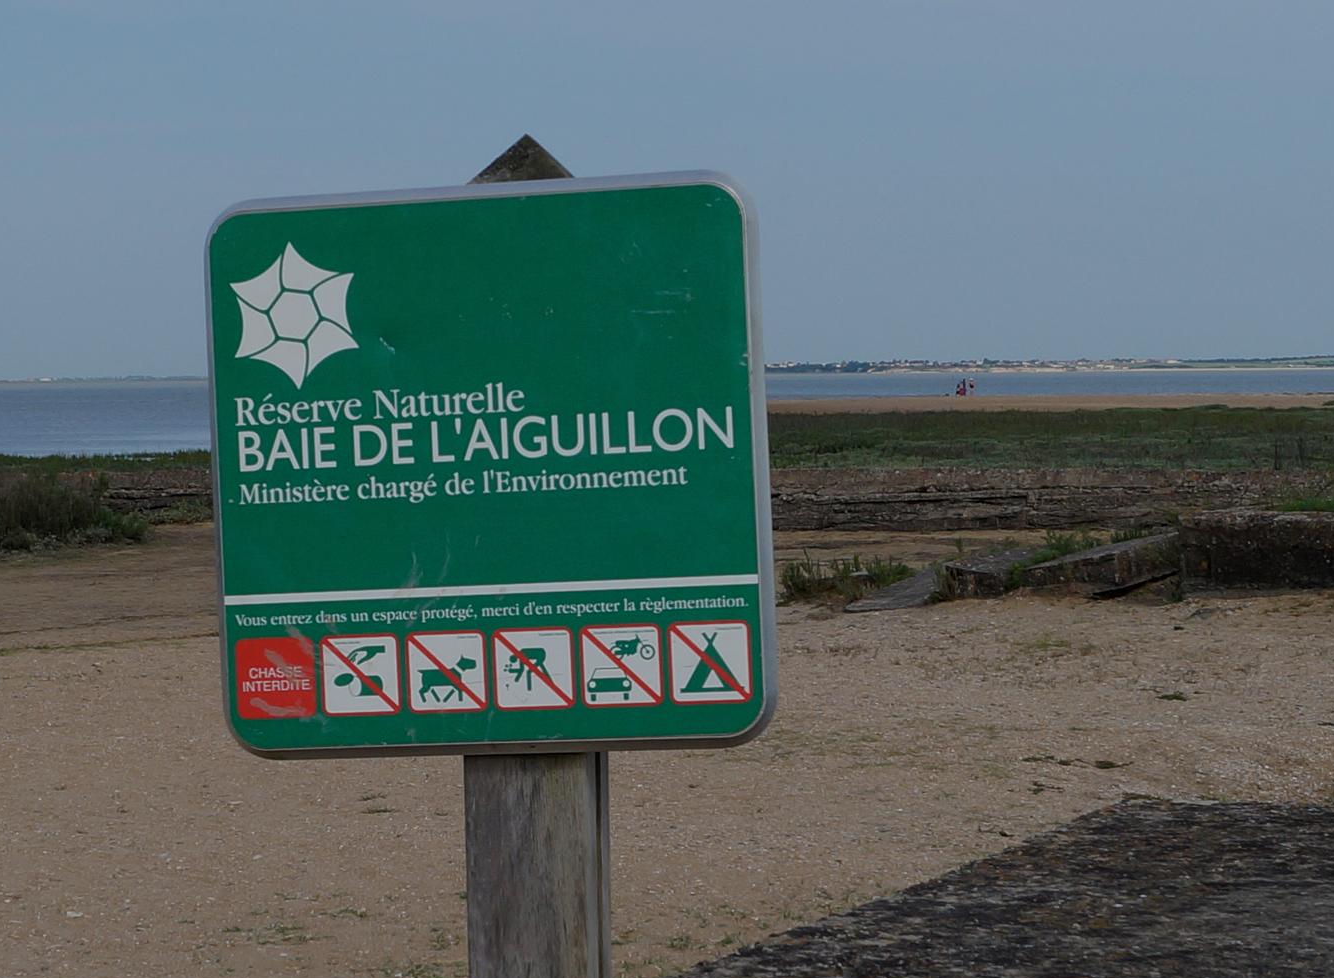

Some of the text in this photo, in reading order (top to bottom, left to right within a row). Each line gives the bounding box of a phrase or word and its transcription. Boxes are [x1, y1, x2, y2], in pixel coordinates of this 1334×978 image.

[235, 382, 525, 427] Réserve Naturelle
[238, 406, 734, 472] BAIE DE L'AIGUILLON
[239, 465, 688, 505] Ministère chargé de l'Environnement
[235, 596, 749, 627] Vous entrez dans un espace protégé, merci d'en respecter la règlementation.
[242, 678, 310, 692] INTERDITE
[248, 665, 303, 679] CHASSE
